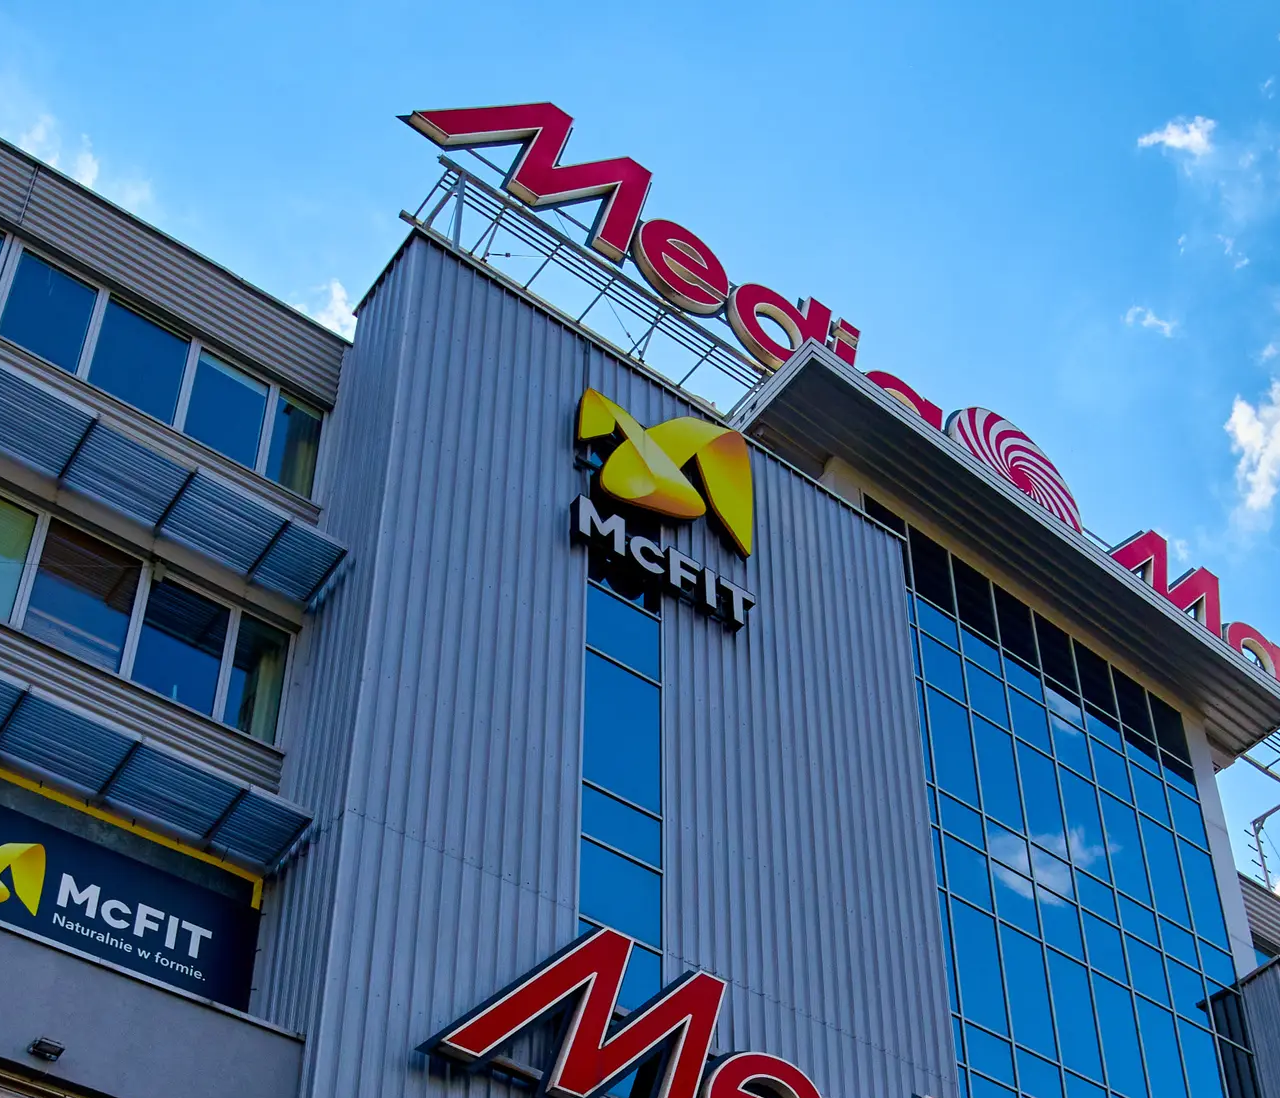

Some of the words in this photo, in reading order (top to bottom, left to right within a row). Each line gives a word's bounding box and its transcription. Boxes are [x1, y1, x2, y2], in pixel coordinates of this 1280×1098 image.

[400, 101, 943, 433] Media
[571, 492, 756, 632] McFIT
[52, 911, 134, 953] Naturalnie
[137, 946, 151, 960] w
[154, 951, 207, 982] formie.
[56, 872, 214, 960] McFIT
